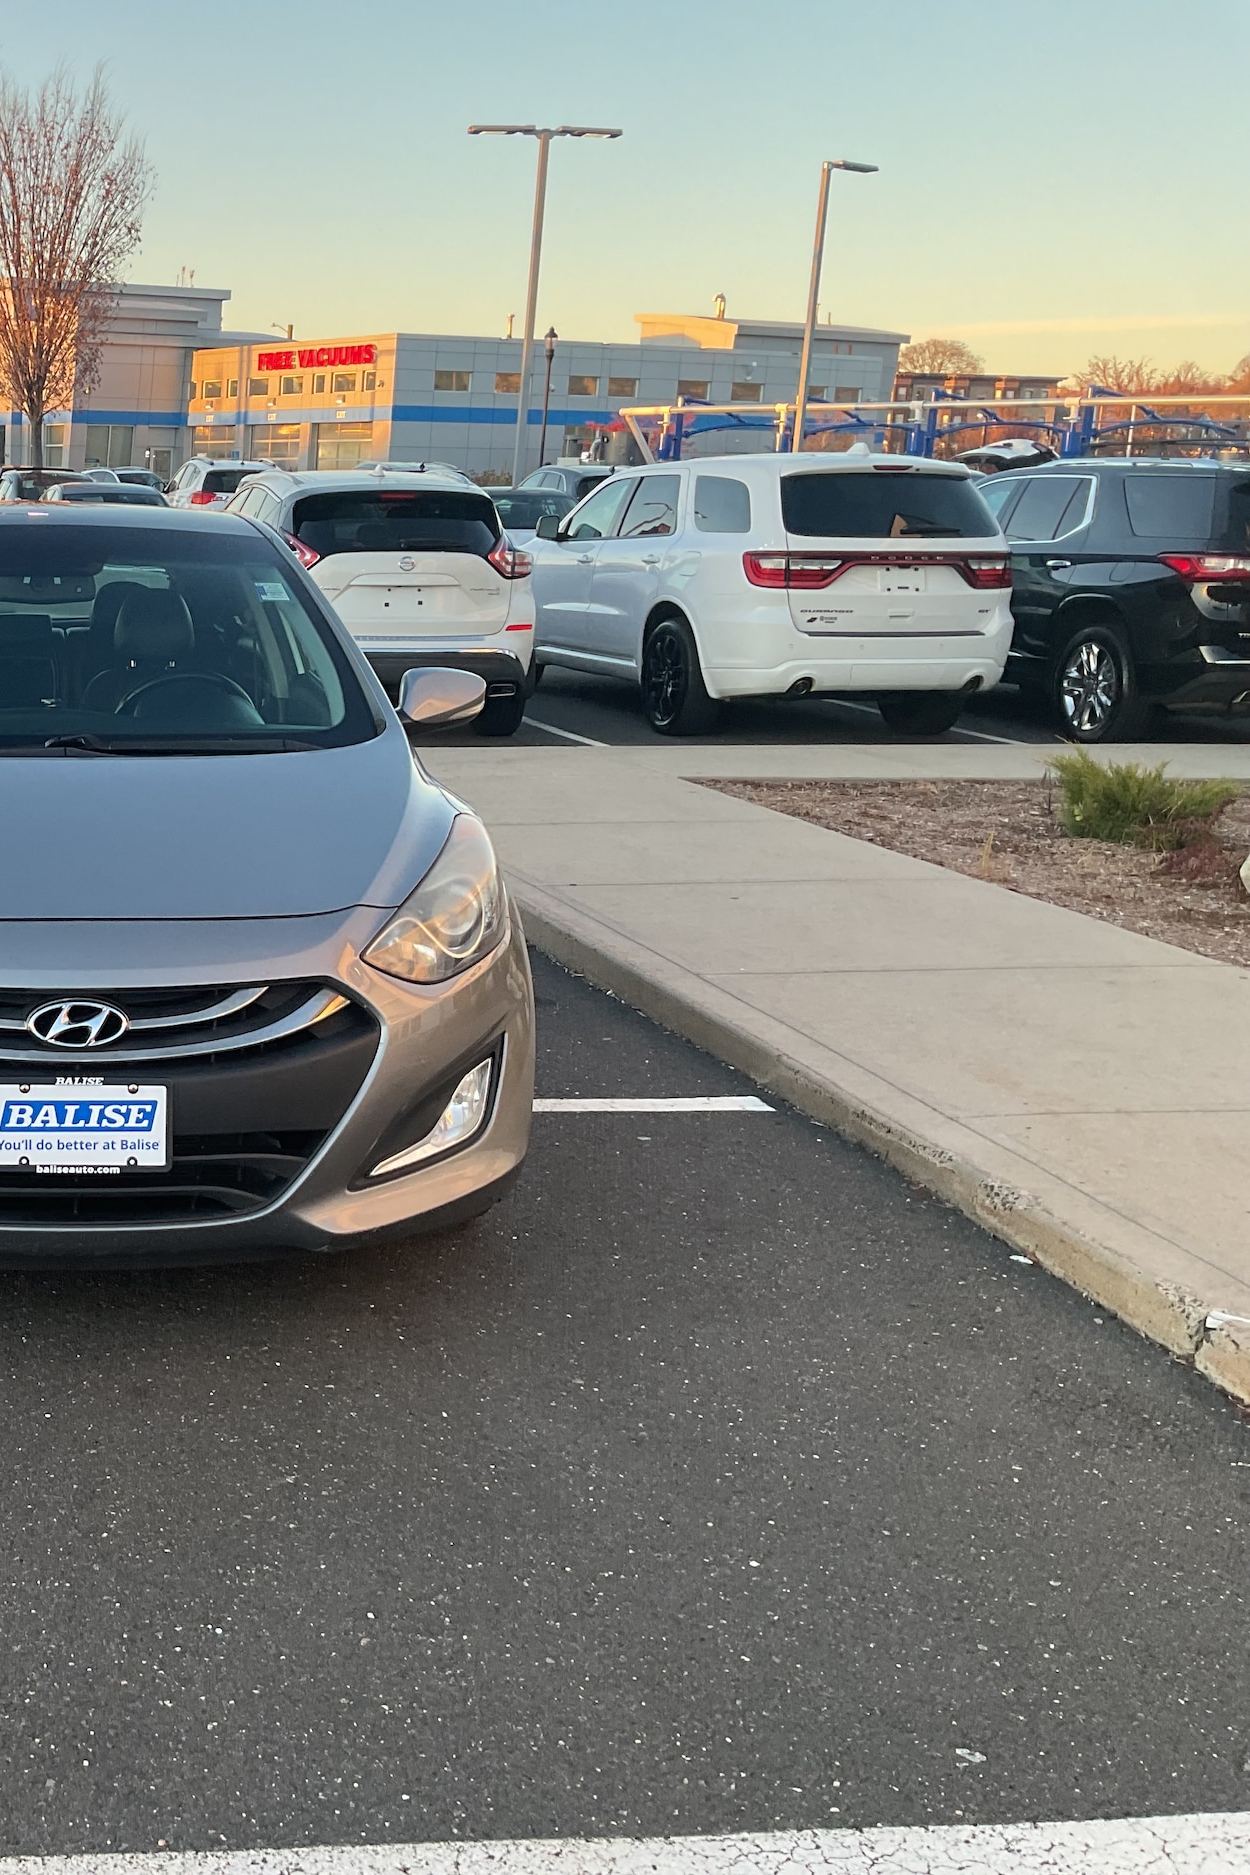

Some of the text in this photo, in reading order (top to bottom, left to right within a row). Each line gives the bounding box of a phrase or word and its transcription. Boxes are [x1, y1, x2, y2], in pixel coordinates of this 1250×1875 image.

[257, 344, 378, 371] FREE VACUUMS
[55, 1076, 104, 1086] BALISE
[4, 1104, 153, 1128] BALISE
[36, 1139, 53, 1151] do
[57, 1139, 99, 1151] better
[102, 1141, 116, 1151] at
[120, 1139, 160, 1151] Balise
[36, 1164, 121, 1175] baliseauto.com
